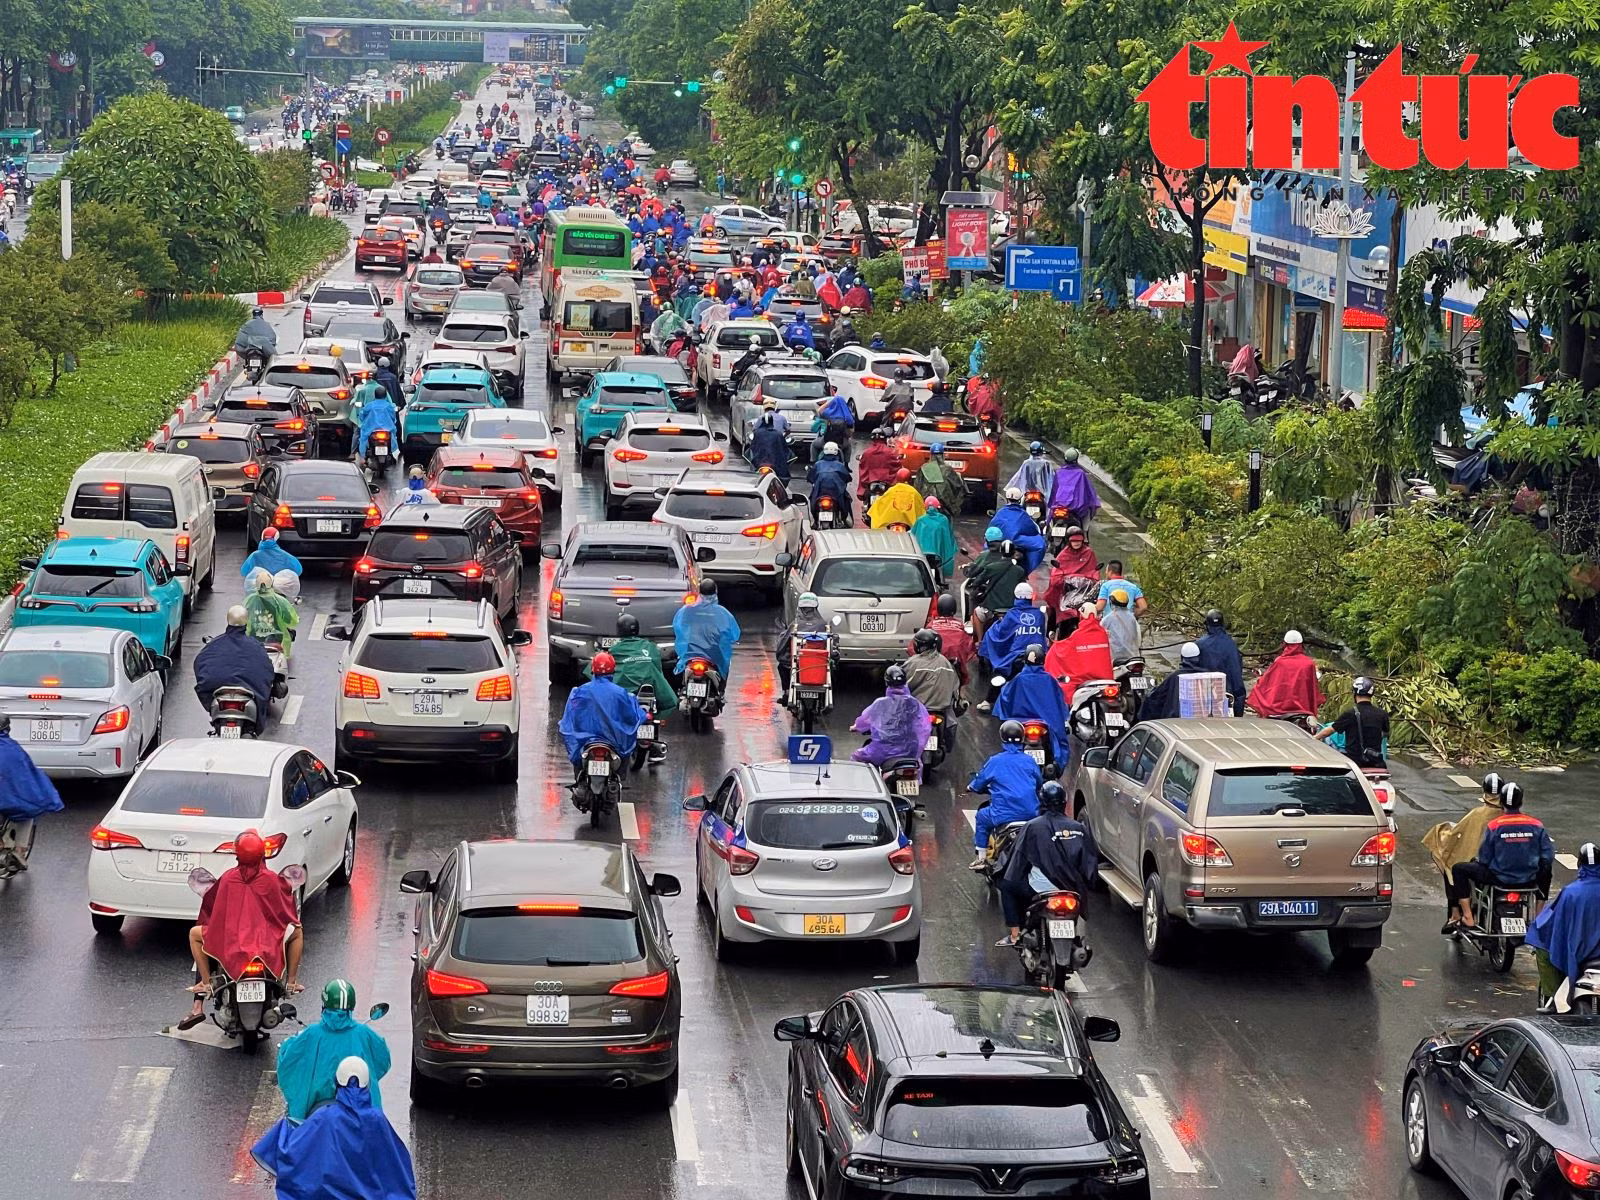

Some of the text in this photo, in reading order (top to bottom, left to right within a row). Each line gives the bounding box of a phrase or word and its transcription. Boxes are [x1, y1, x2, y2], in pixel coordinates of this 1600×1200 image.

[420, 695, 436, 704] 29A
[37, 721, 54, 730] 98A
[799, 739, 821, 761] G7
[812, 805, 828, 813] 32
[829, 805, 844, 813] 32
[845, 805, 860, 813] 32
[170, 852, 189, 861] 30G
[1261, 902, 1316, 915] 29A-040.11
[815, 915, 833, 925] 30A
[808, 925, 841, 934] 495.64
[537, 996, 559, 1009] 30A
[528, 1010, 568, 1023] 998.92
